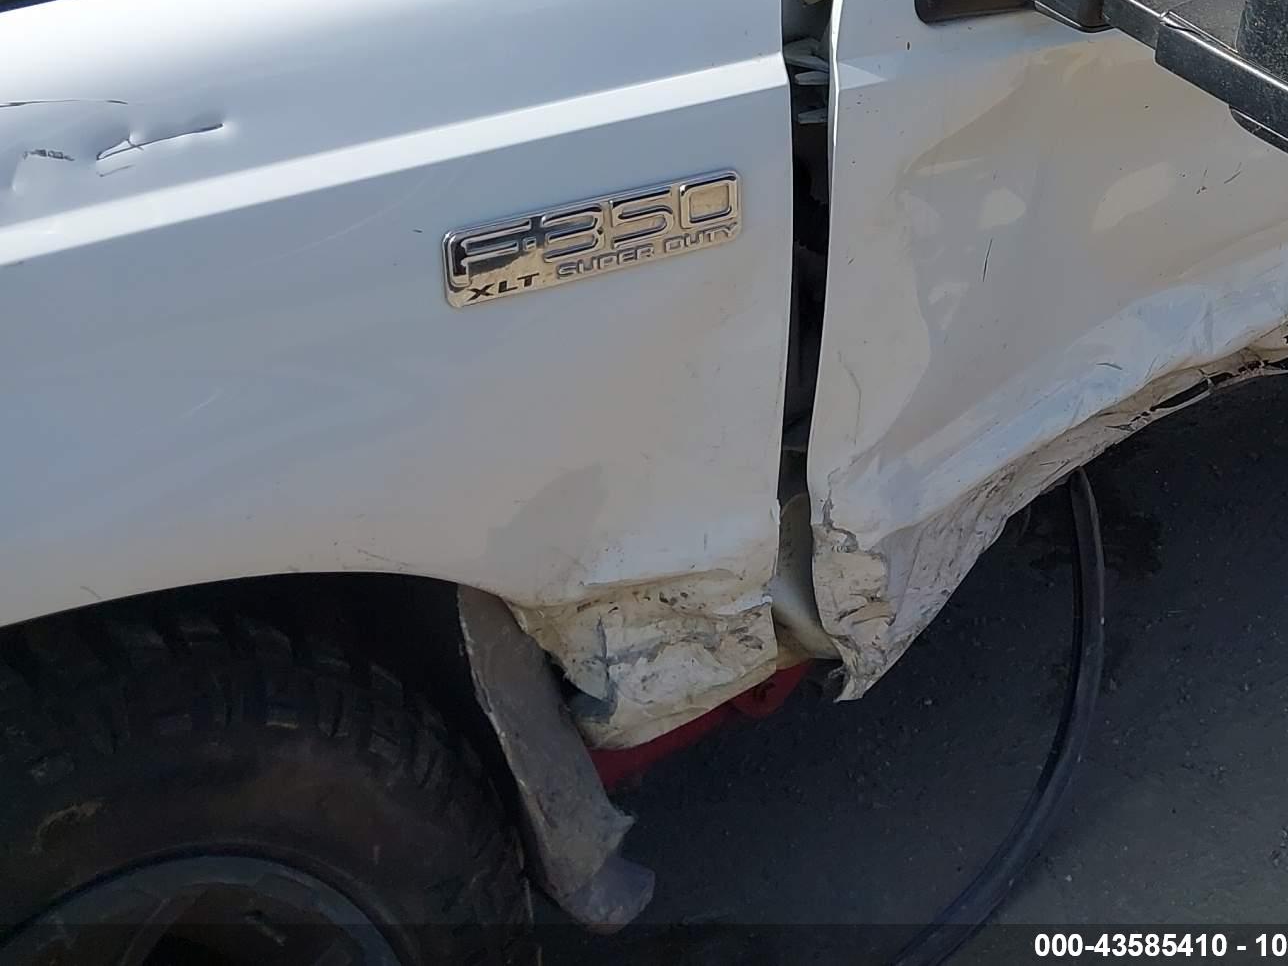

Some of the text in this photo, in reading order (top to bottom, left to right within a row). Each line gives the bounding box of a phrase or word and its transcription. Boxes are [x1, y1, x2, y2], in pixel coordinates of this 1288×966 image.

[466, 222, 738, 302] XLT SUPER DUTY
